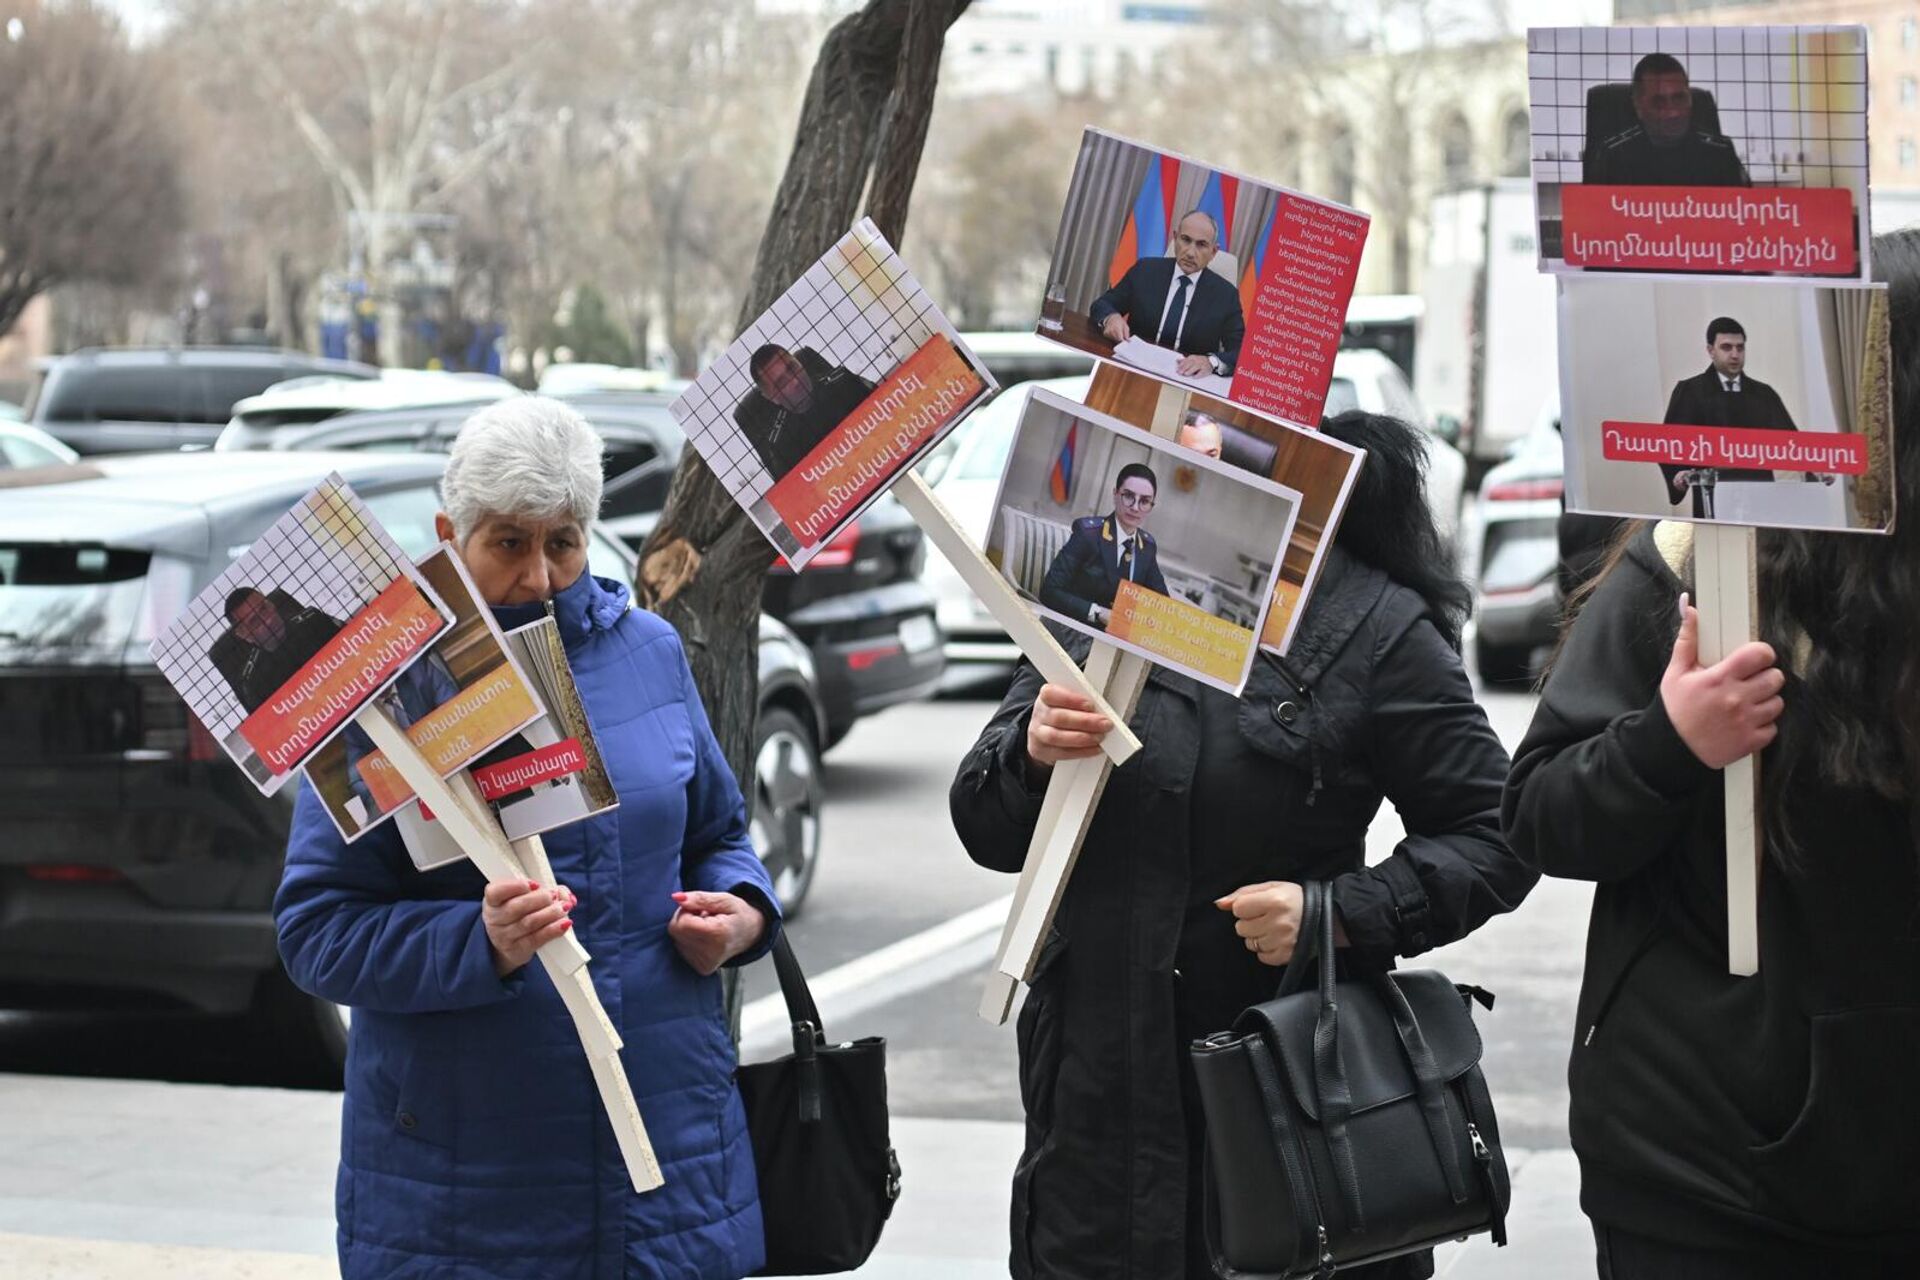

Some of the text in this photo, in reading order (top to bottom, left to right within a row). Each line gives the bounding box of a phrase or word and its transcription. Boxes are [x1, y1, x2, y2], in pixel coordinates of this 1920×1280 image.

[1572, 231, 1724, 264] կողմնակալ
[1730, 234, 1837, 266] քննիչին
[1611, 194, 1800, 227] Կալանավորել
[794, 373, 969, 541] կողմնակալ քննիչին
[798, 368, 927, 488] Կալանավորել
[1605, 429, 1859, 467] Դատը չի կայանալու
[266, 612, 432, 770] կողմնակալ քննիչին
[270, 608, 392, 720] Կալանավորել
[489, 743, 581, 793] կայանալու
